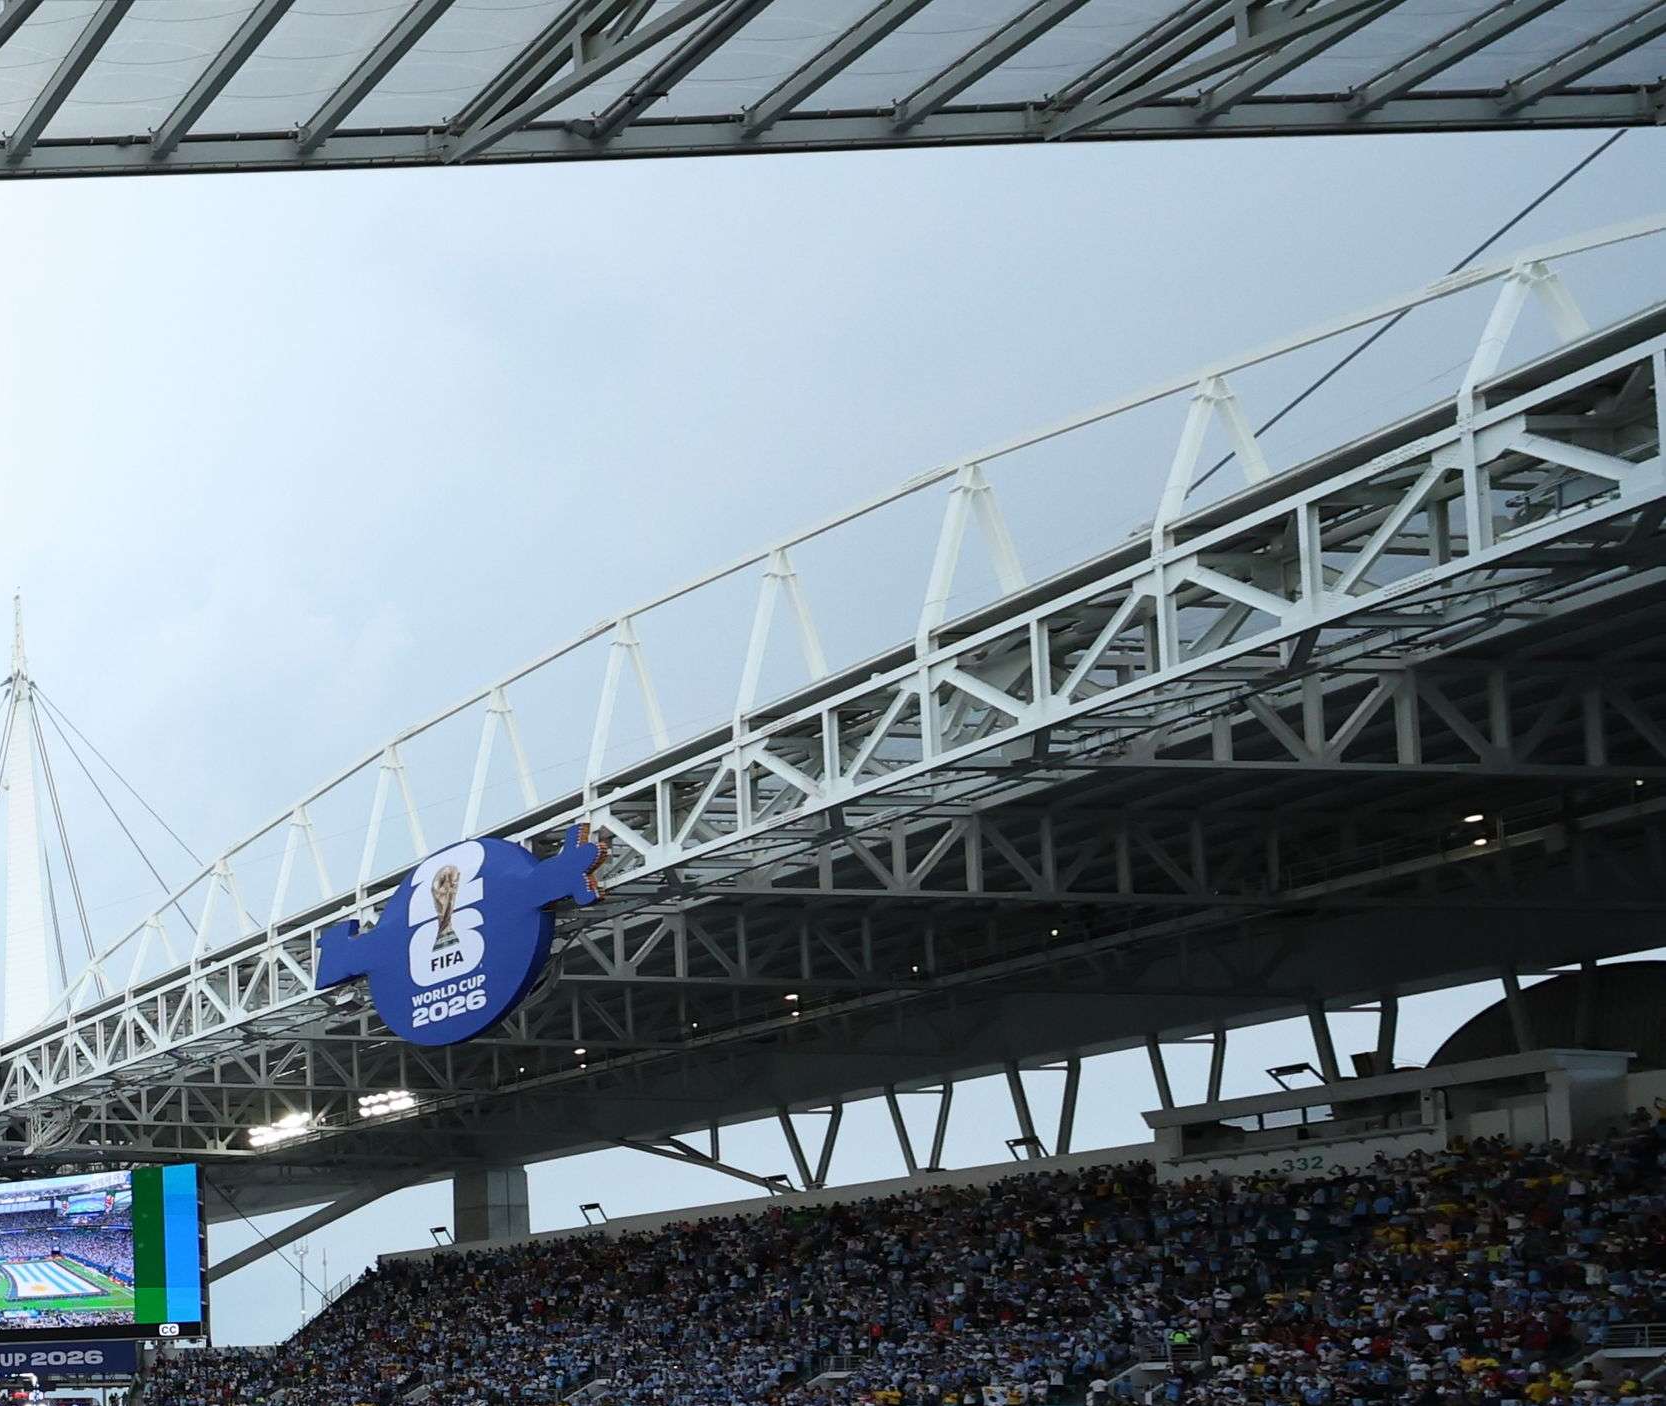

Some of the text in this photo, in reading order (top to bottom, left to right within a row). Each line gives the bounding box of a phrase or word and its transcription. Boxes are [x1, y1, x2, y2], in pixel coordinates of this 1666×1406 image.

[430, 950, 464, 972] FIFA
[412, 975, 486, 1008] WORLD CUP
[412, 989, 487, 1028] 2026
[1282, 1156, 1323, 1175] 332
[160, 1325, 177, 1335] CC
[31, 1349, 103, 1366] 2026
